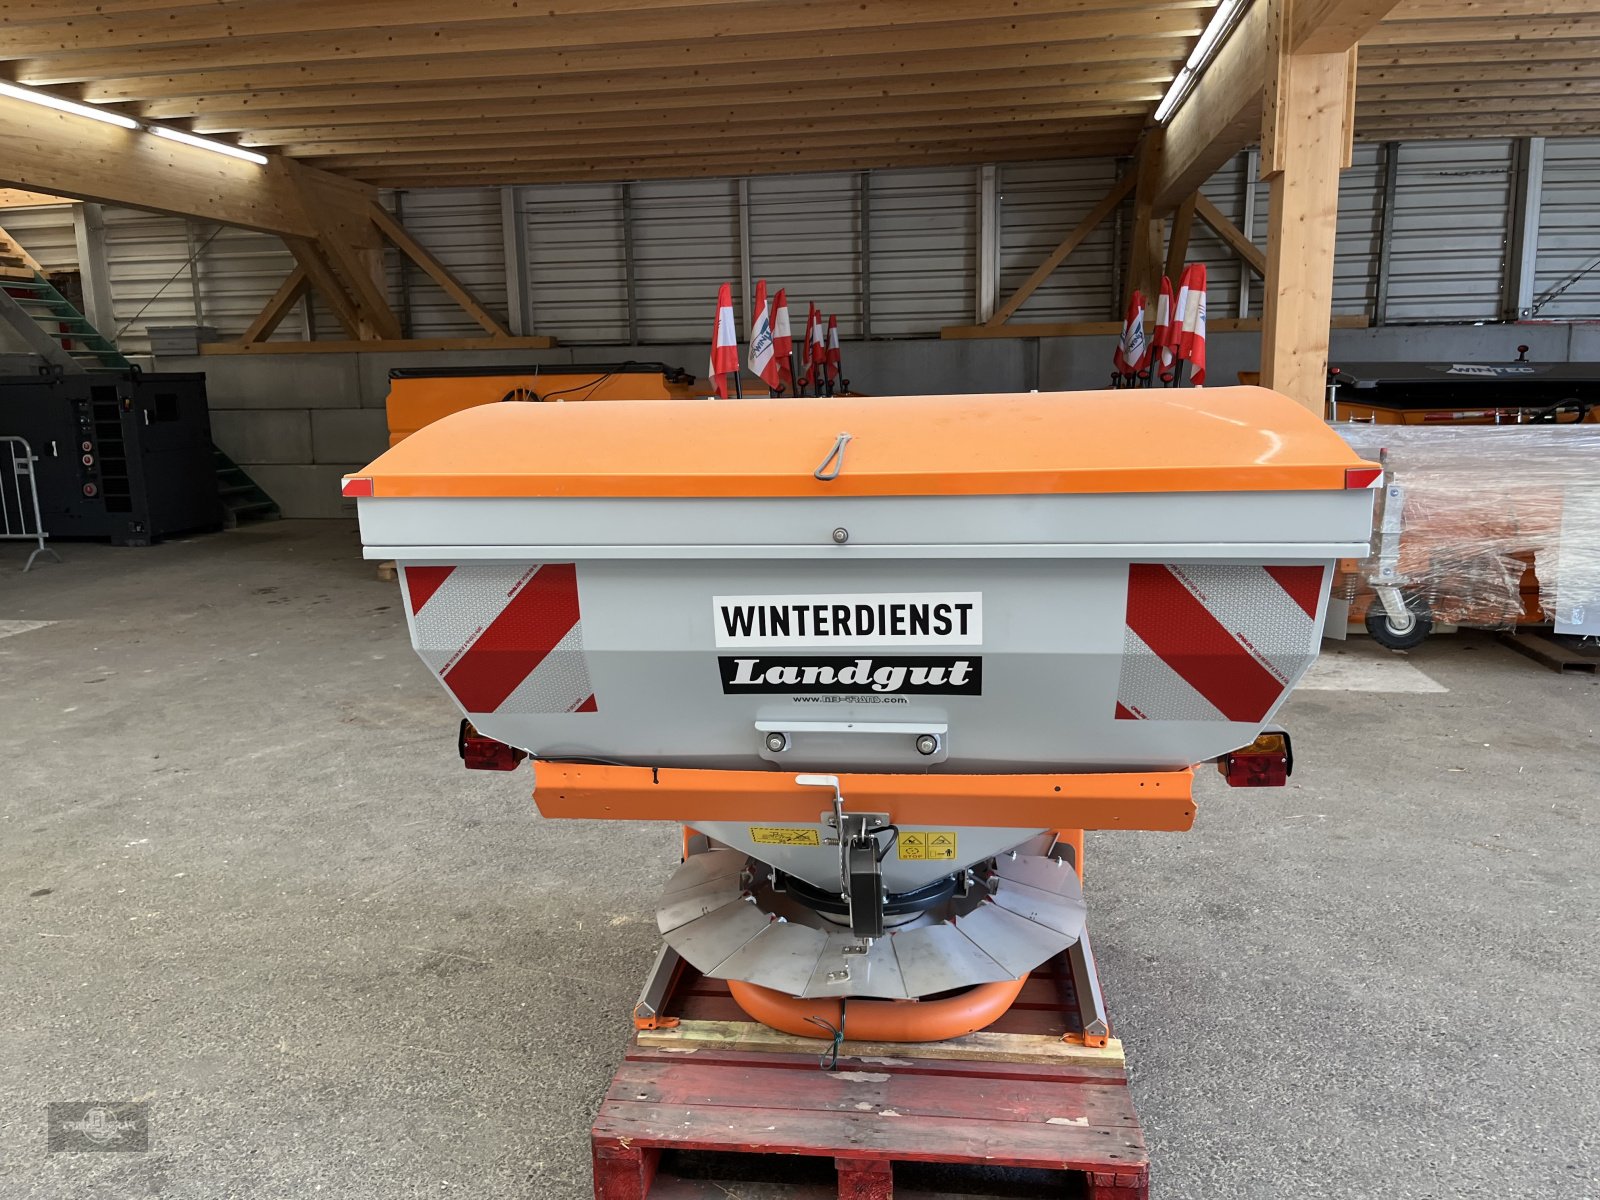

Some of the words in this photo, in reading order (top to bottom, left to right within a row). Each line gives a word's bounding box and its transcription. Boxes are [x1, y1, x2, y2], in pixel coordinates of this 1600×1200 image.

[1451, 366, 1535, 374] WINTEC
[721, 603, 973, 636] WINTERDIENST
[729, 659, 973, 692] Landgut
